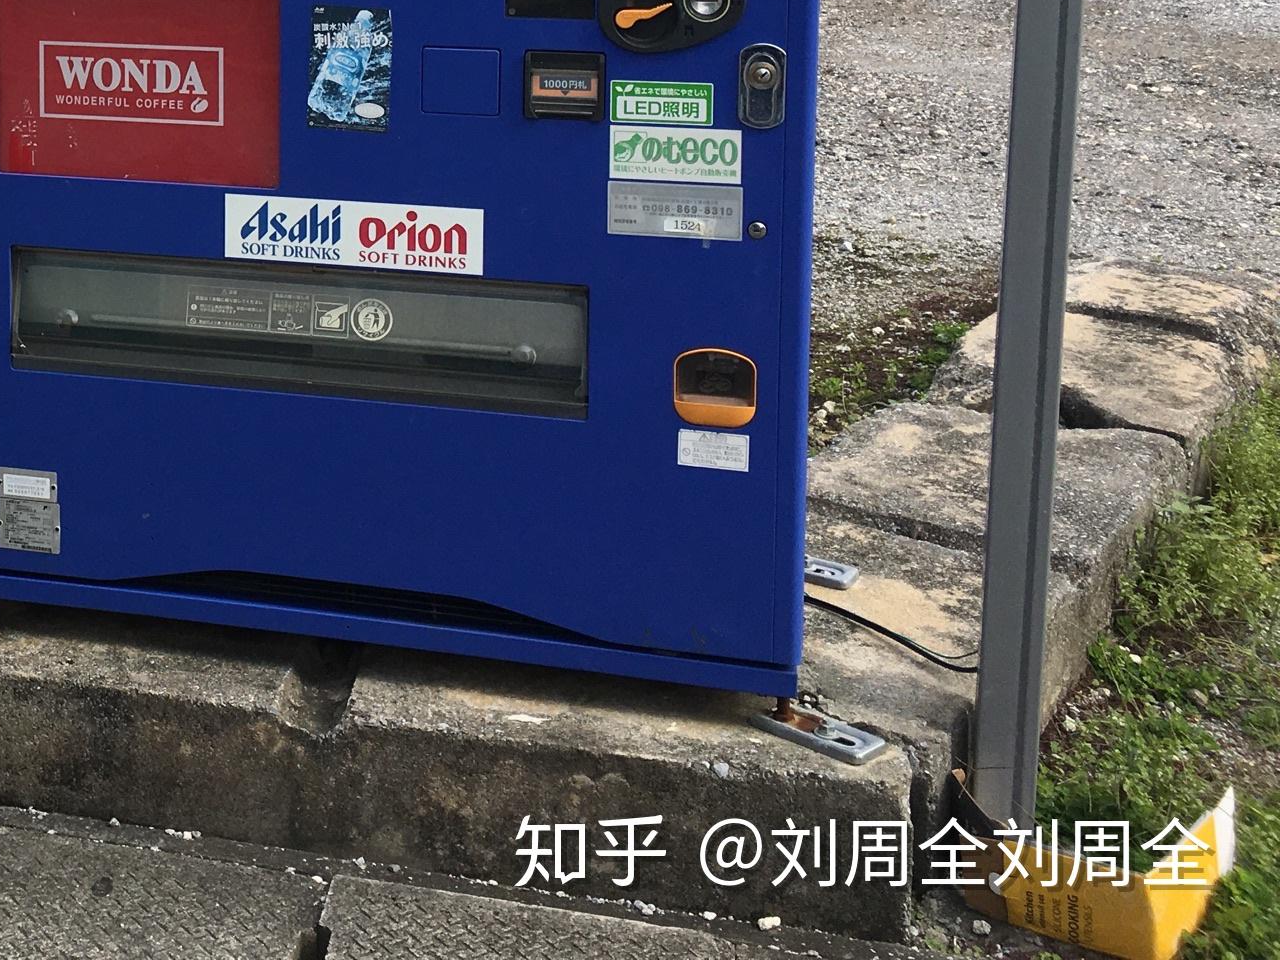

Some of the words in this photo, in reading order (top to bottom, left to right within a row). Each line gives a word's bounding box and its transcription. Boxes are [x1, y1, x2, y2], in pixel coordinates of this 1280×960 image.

[55, 56, 208, 95] WONDA
[543, 80, 587, 90] 1000円札
[55, 94, 130, 108] WONDERFUL
[135, 98, 184, 110] COFFEE
[623, 100, 700, 119] LED照明
[641, 136, 738, 167] のむeco
[240, 200, 341, 246] Asahi
[241, 241, 280, 257] SOFT
[283, 245, 341, 261] DRINKS
[358, 250, 400, 265] SOFT
[405, 253, 467, 270] DRINKS
[1067, 894, 1080, 945] COOKING
